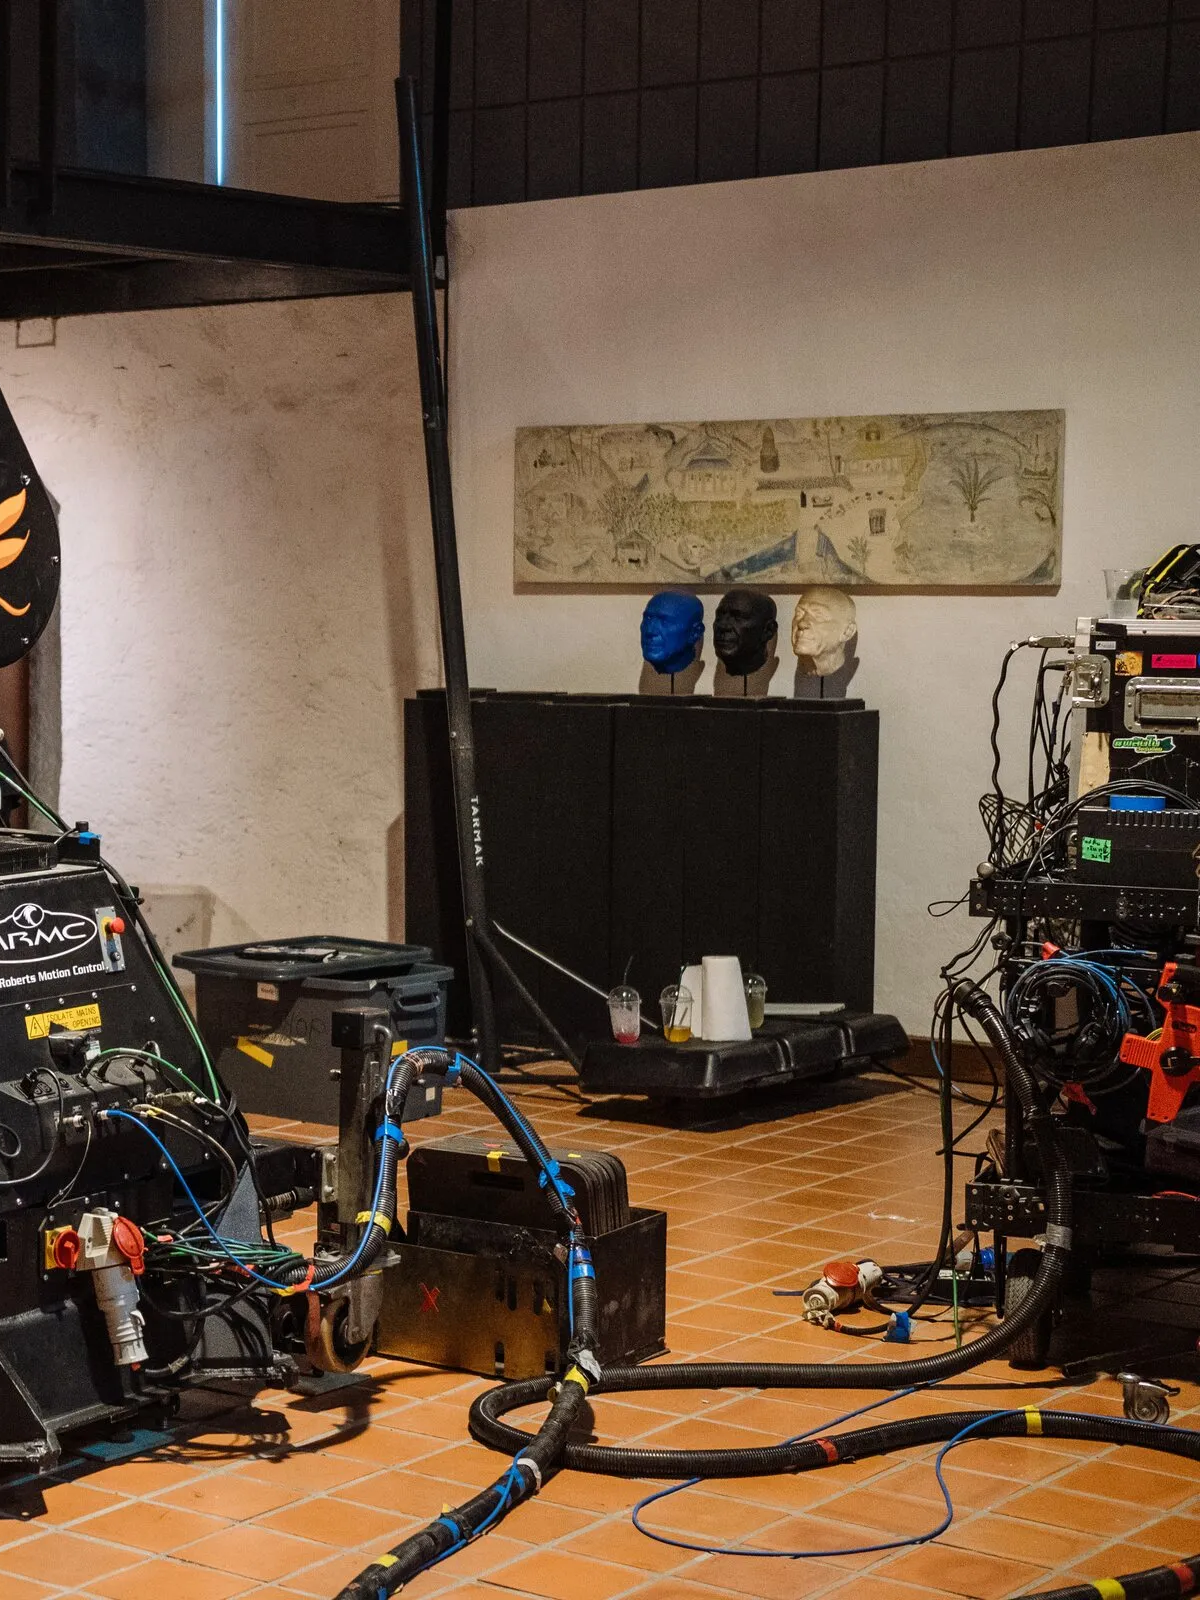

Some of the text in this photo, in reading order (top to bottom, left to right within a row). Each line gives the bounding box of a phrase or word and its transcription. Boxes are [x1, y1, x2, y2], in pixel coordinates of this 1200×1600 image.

[470, 795, 484, 867] TARMAK
[38, 968, 71, 981] Motion
[72, 961, 106, 976] Control
[46, 1006, 97, 1022] ISOLATE MAINS
[72, 1016, 100, 1028] OPENING
